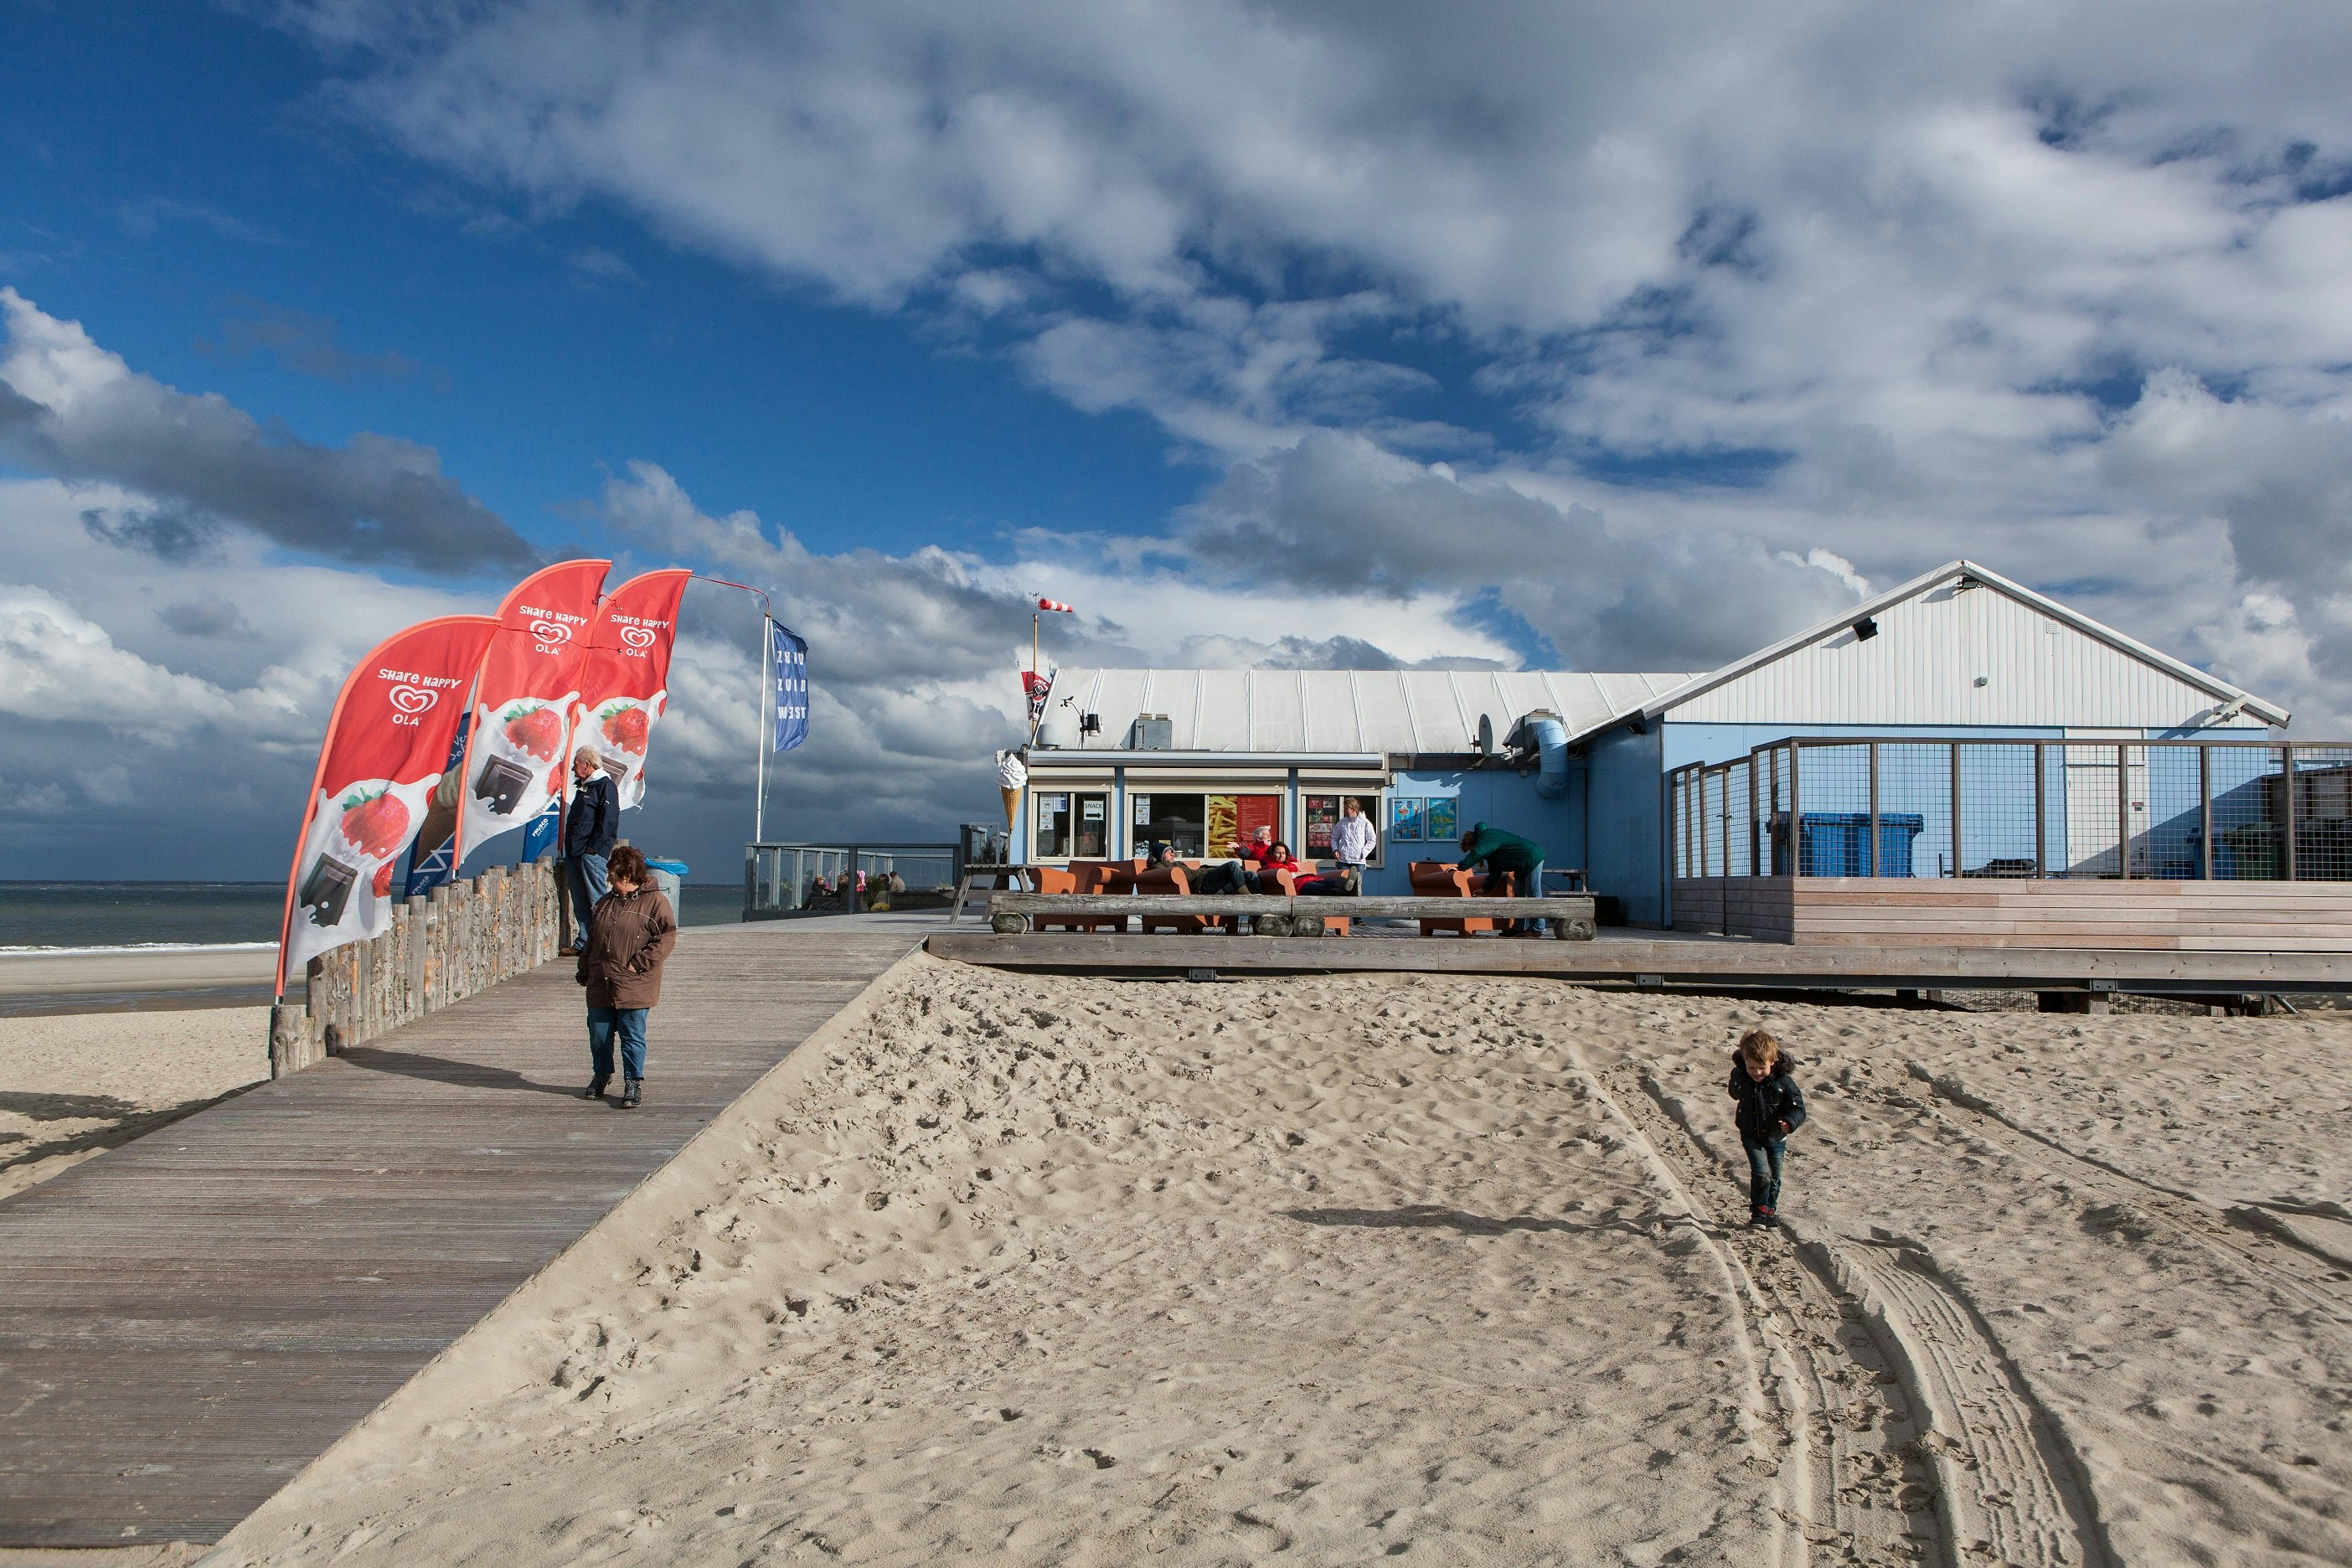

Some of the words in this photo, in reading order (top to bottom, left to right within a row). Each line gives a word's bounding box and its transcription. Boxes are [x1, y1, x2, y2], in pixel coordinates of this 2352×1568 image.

[535, 643, 560, 655] OLA
[626, 647, 646, 658] OLA
[392, 714, 420, 726] OLA
